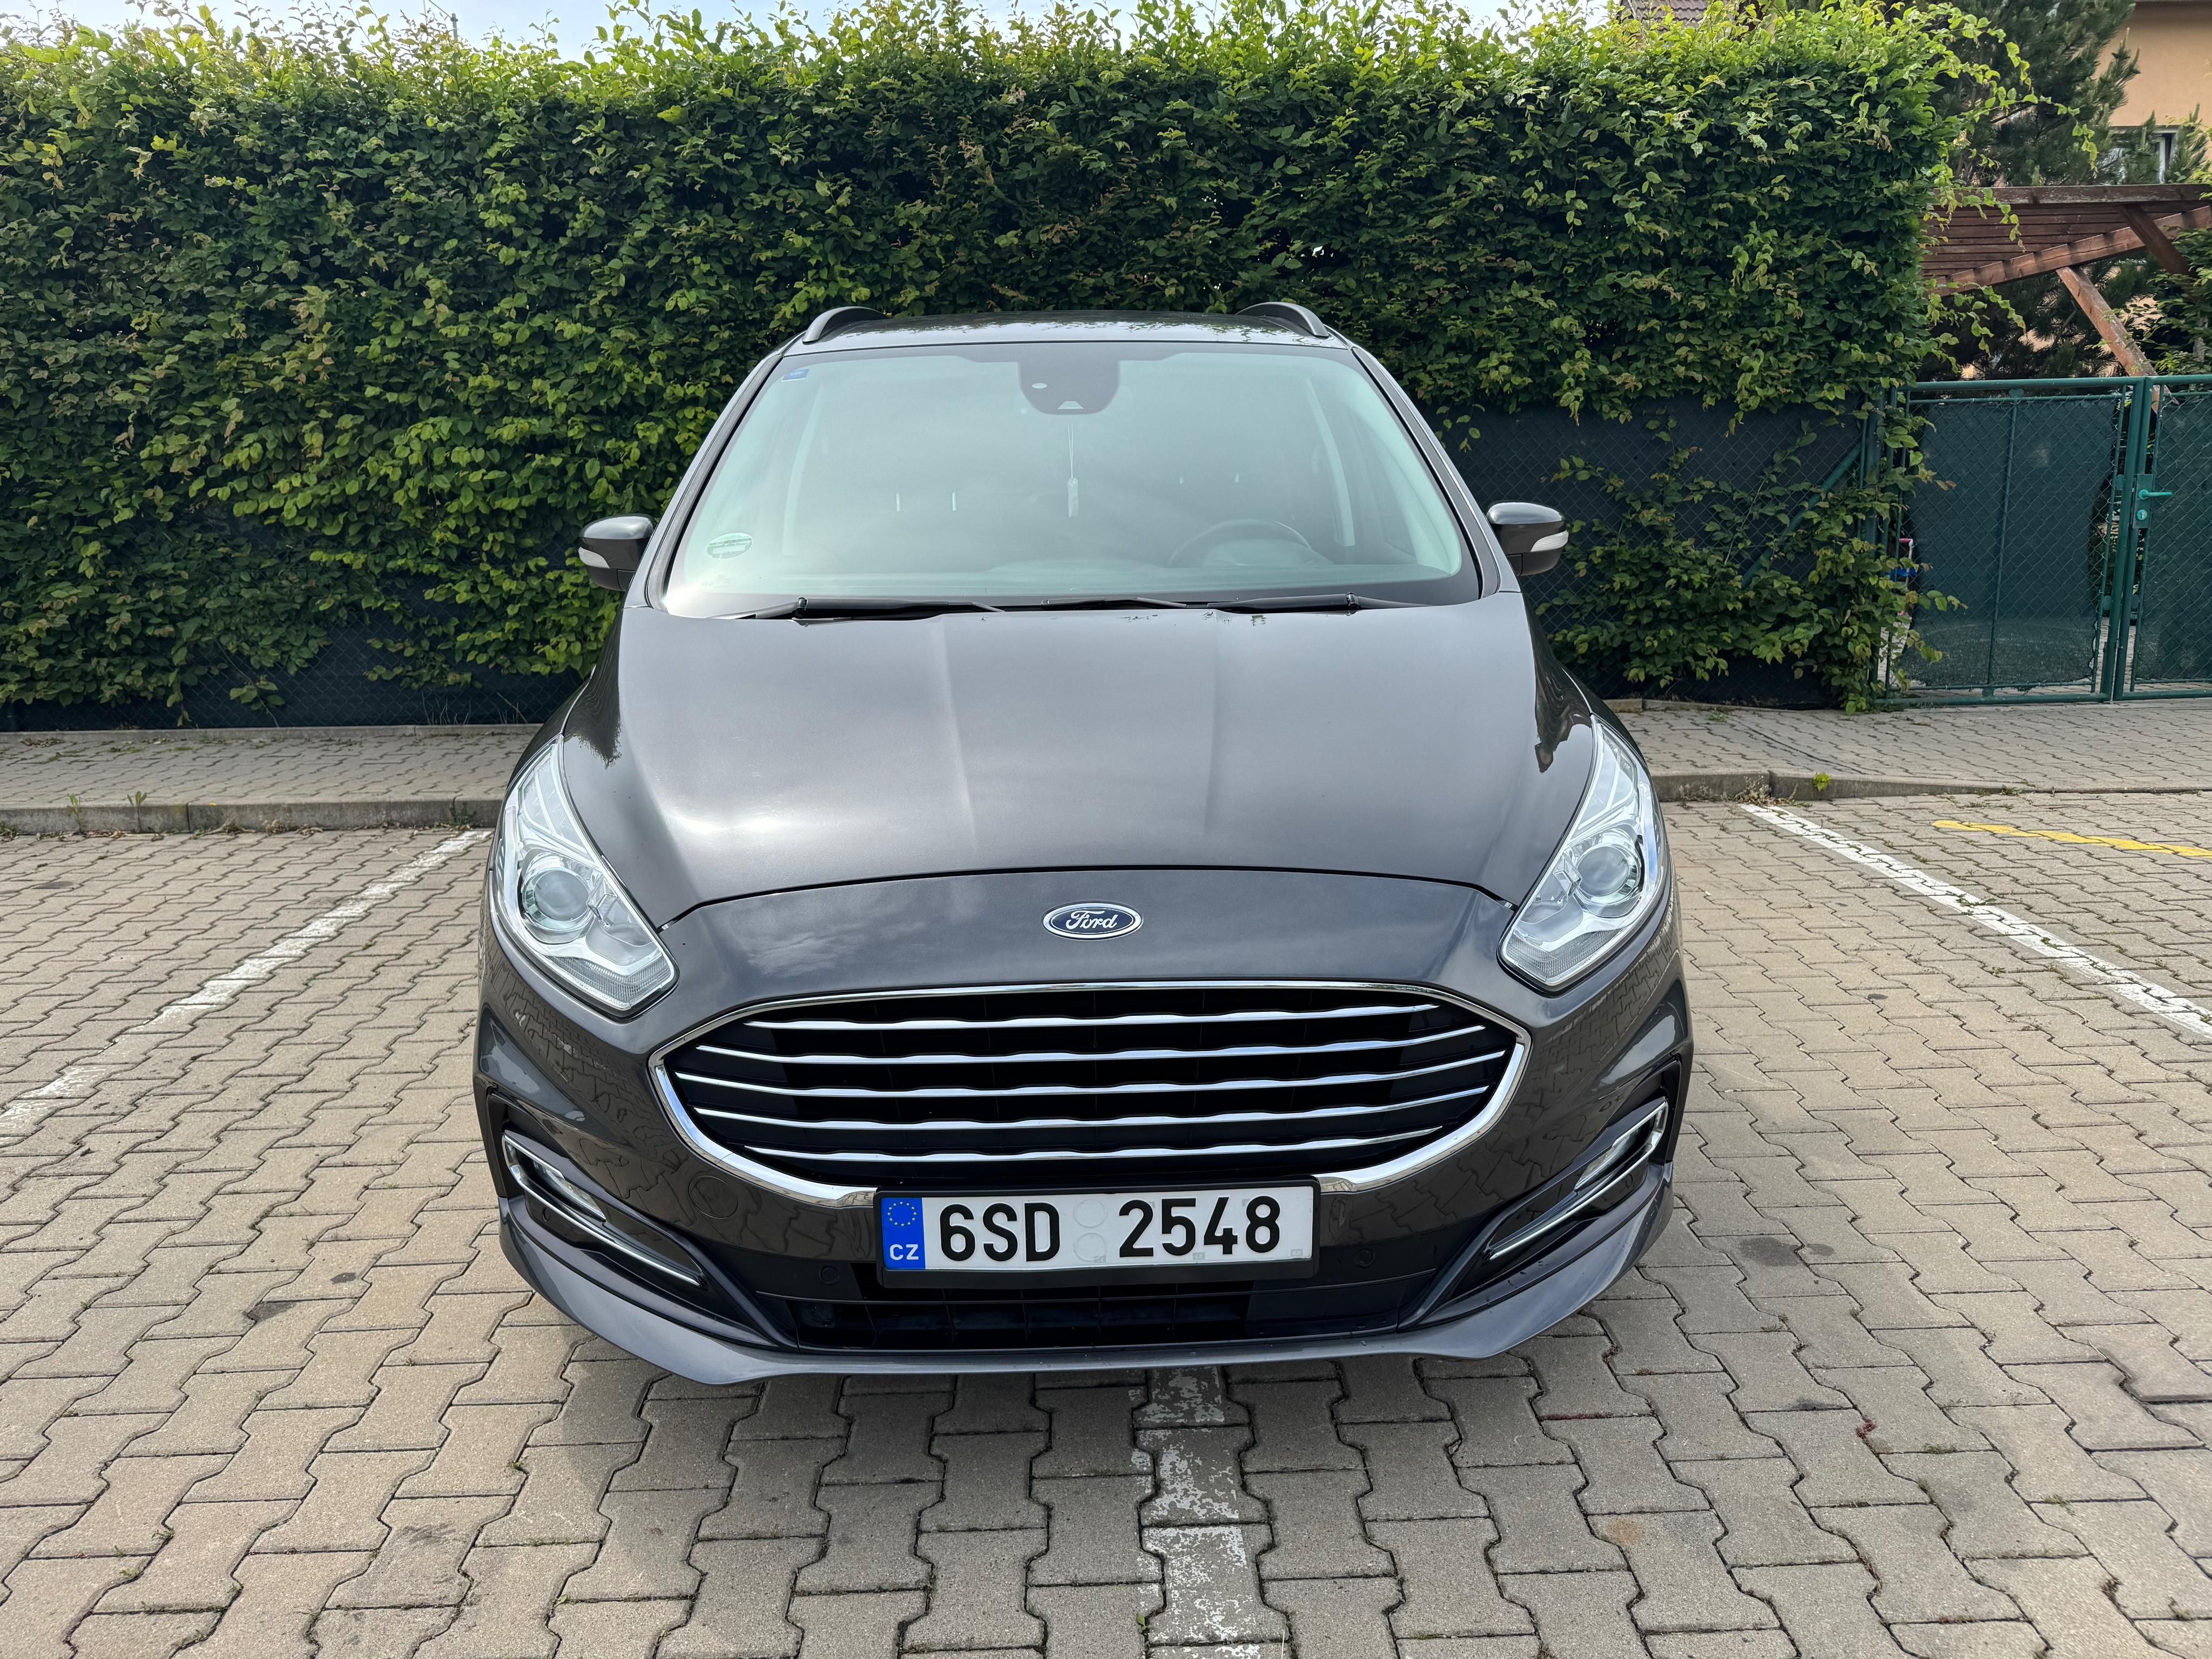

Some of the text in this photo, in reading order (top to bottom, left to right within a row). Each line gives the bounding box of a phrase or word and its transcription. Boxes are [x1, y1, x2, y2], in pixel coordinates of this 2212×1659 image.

[1065, 910, 1118, 929] Ford
[940, 1196, 1280, 1262] 6SD 2548
[889, 1244, 920, 1261] CZ
